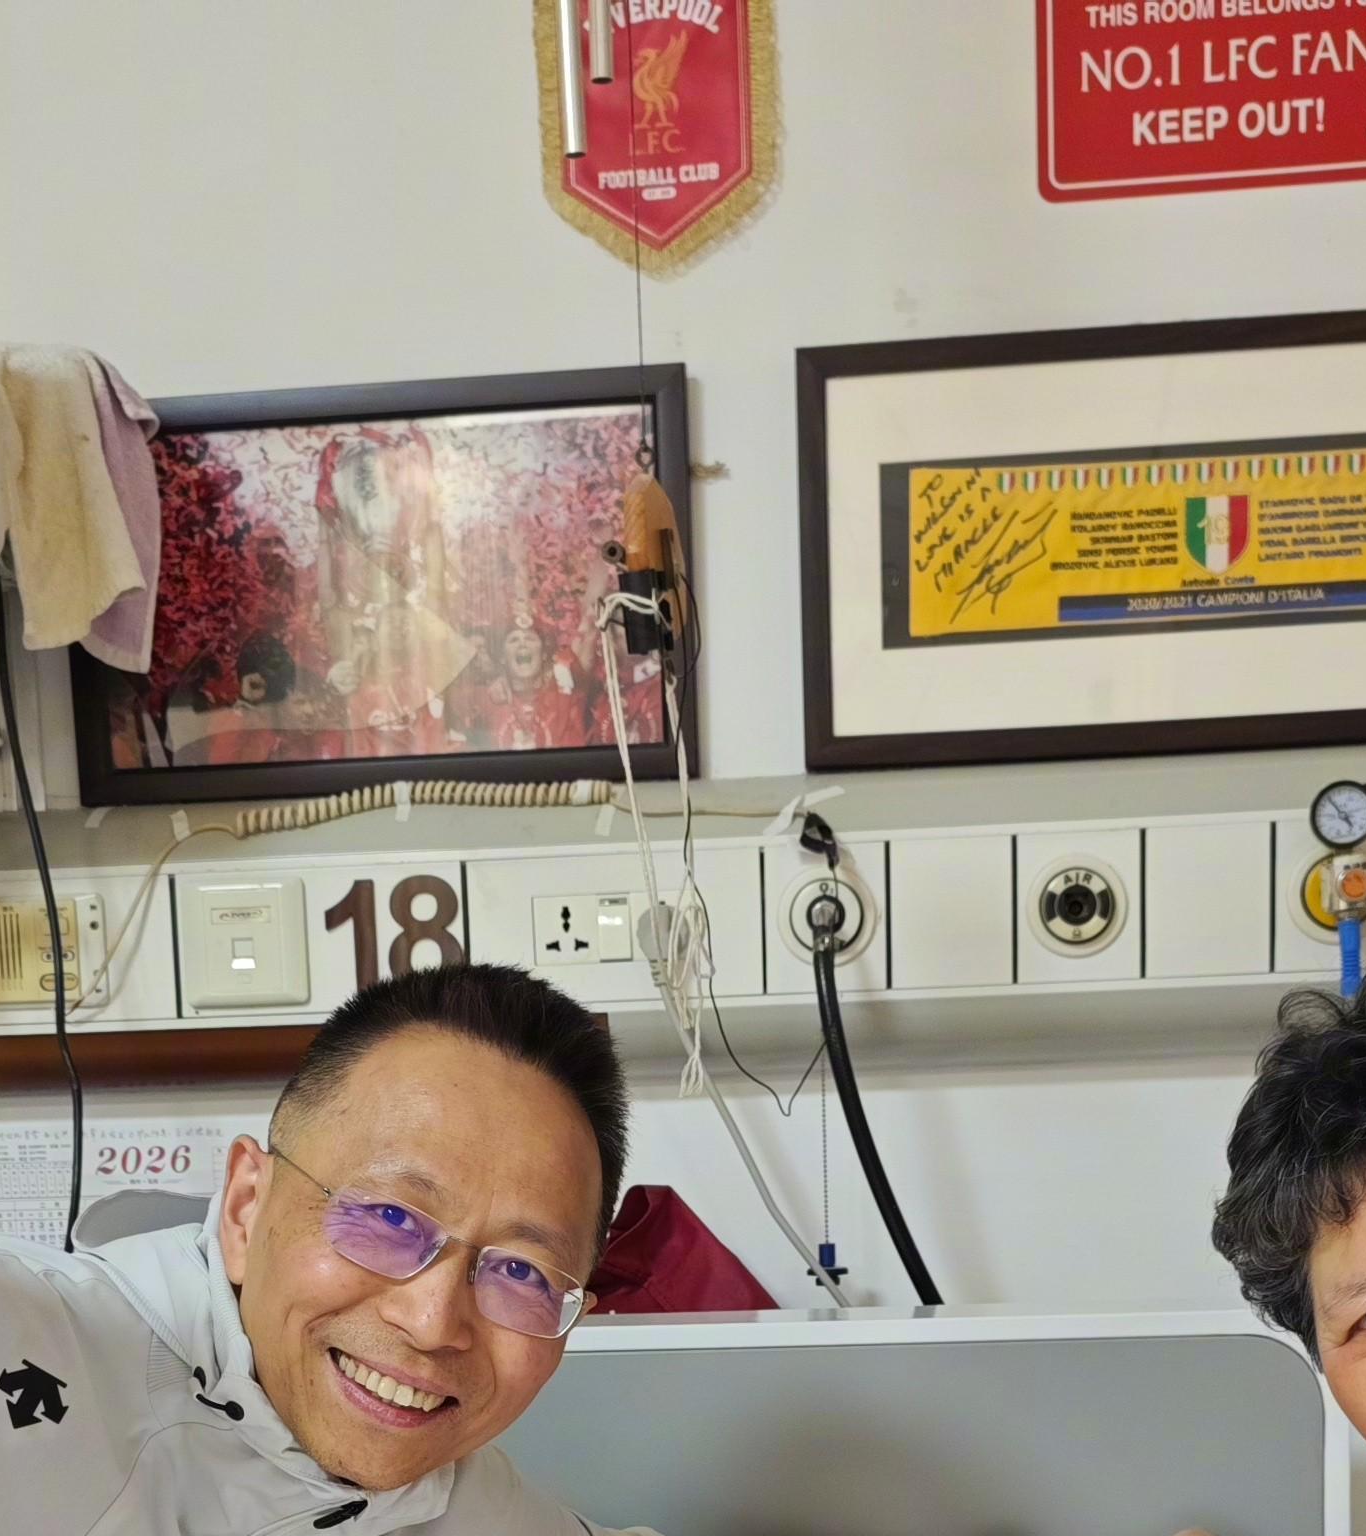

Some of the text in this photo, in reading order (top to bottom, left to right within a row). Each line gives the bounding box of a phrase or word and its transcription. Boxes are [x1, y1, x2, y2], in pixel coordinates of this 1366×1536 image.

[1085, 3, 1138, 28] THIS
[1144, 0, 1215, 23] ROOM
[1080, 44, 1181, 92] NO.1
[1202, 35, 1278, 83] LFC
[1132, 97, 1325, 146] KEEP OUT!
[598, 162, 720, 190] FOOTBALL CLUB
[1197, 589, 1265, 607] CAMPIONI
[1062, 873, 1093, 885] AIR
[325, 874, 465, 994] 18
[95, 1144, 193, 1176] 2026
